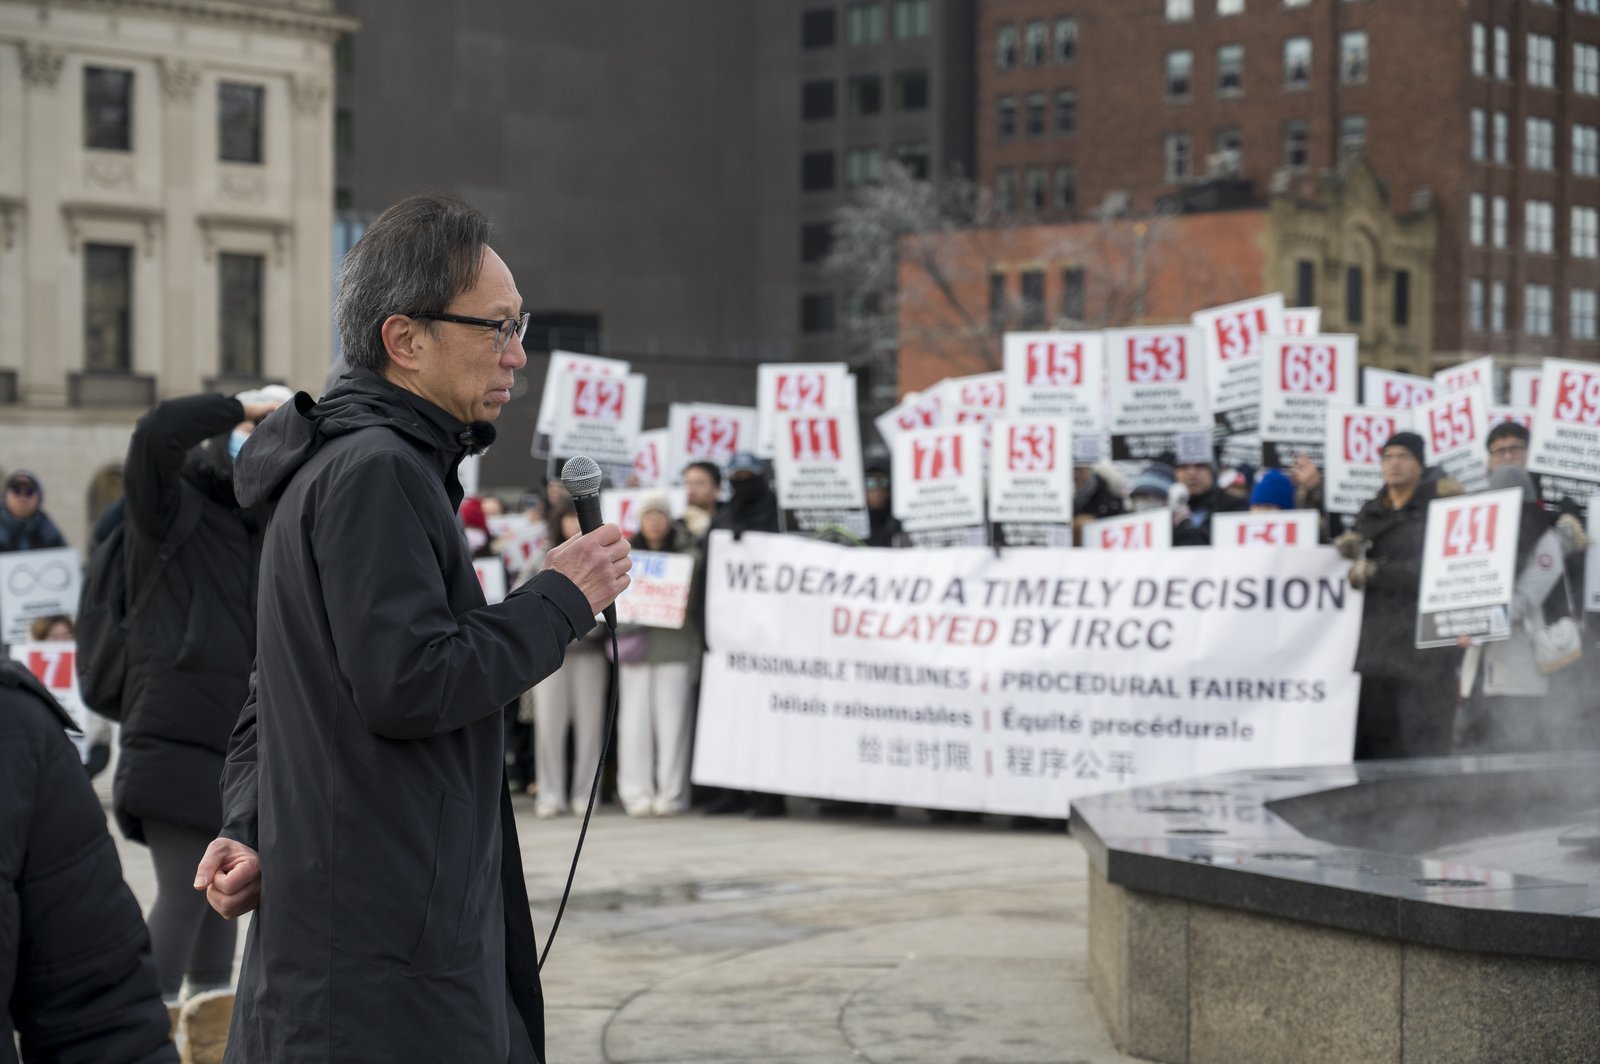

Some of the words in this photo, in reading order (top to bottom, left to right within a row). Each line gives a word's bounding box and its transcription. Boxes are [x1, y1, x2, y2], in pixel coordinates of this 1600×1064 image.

[1215, 308, 1266, 360] 31
[1027, 342, 1083, 385] 15
[1127, 335, 1186, 382] 53
[1280, 345, 1336, 393] 68
[574, 379, 625, 422] 42
[775, 373, 825, 411] 42
[1553, 370, 1600, 425] 39
[686, 416, 739, 457] 32
[790, 418, 841, 460] 11
[1429, 396, 1475, 454] 55
[912, 436, 962, 480] 71
[1008, 425, 1055, 471] 53
[1442, 503, 1498, 557] 41
[725, 560, 767, 594] WE
[773, 563, 935, 605] DEMAND
[940, 577, 967, 605] A
[984, 578, 1124, 609] TIMELY
[1132, 576, 1346, 611] DECISION
[830, 606, 998, 646] DELAYED
[1010, 617, 1061, 648] BY
[1070, 617, 1174, 651] IRCC
[28, 651, 73, 689] 7
[726, 650, 846, 682] REASONABLE
[854, 662, 971, 691] TIMELINES
[1001, 670, 1181, 700] PROCEDURAL
[1189, 677, 1327, 704] FAIRNESS
[1001, 704, 1082, 735] Équité
[1089, 714, 1255, 742] procédurale
[1006, 744, 1137, 783] 程序公平
